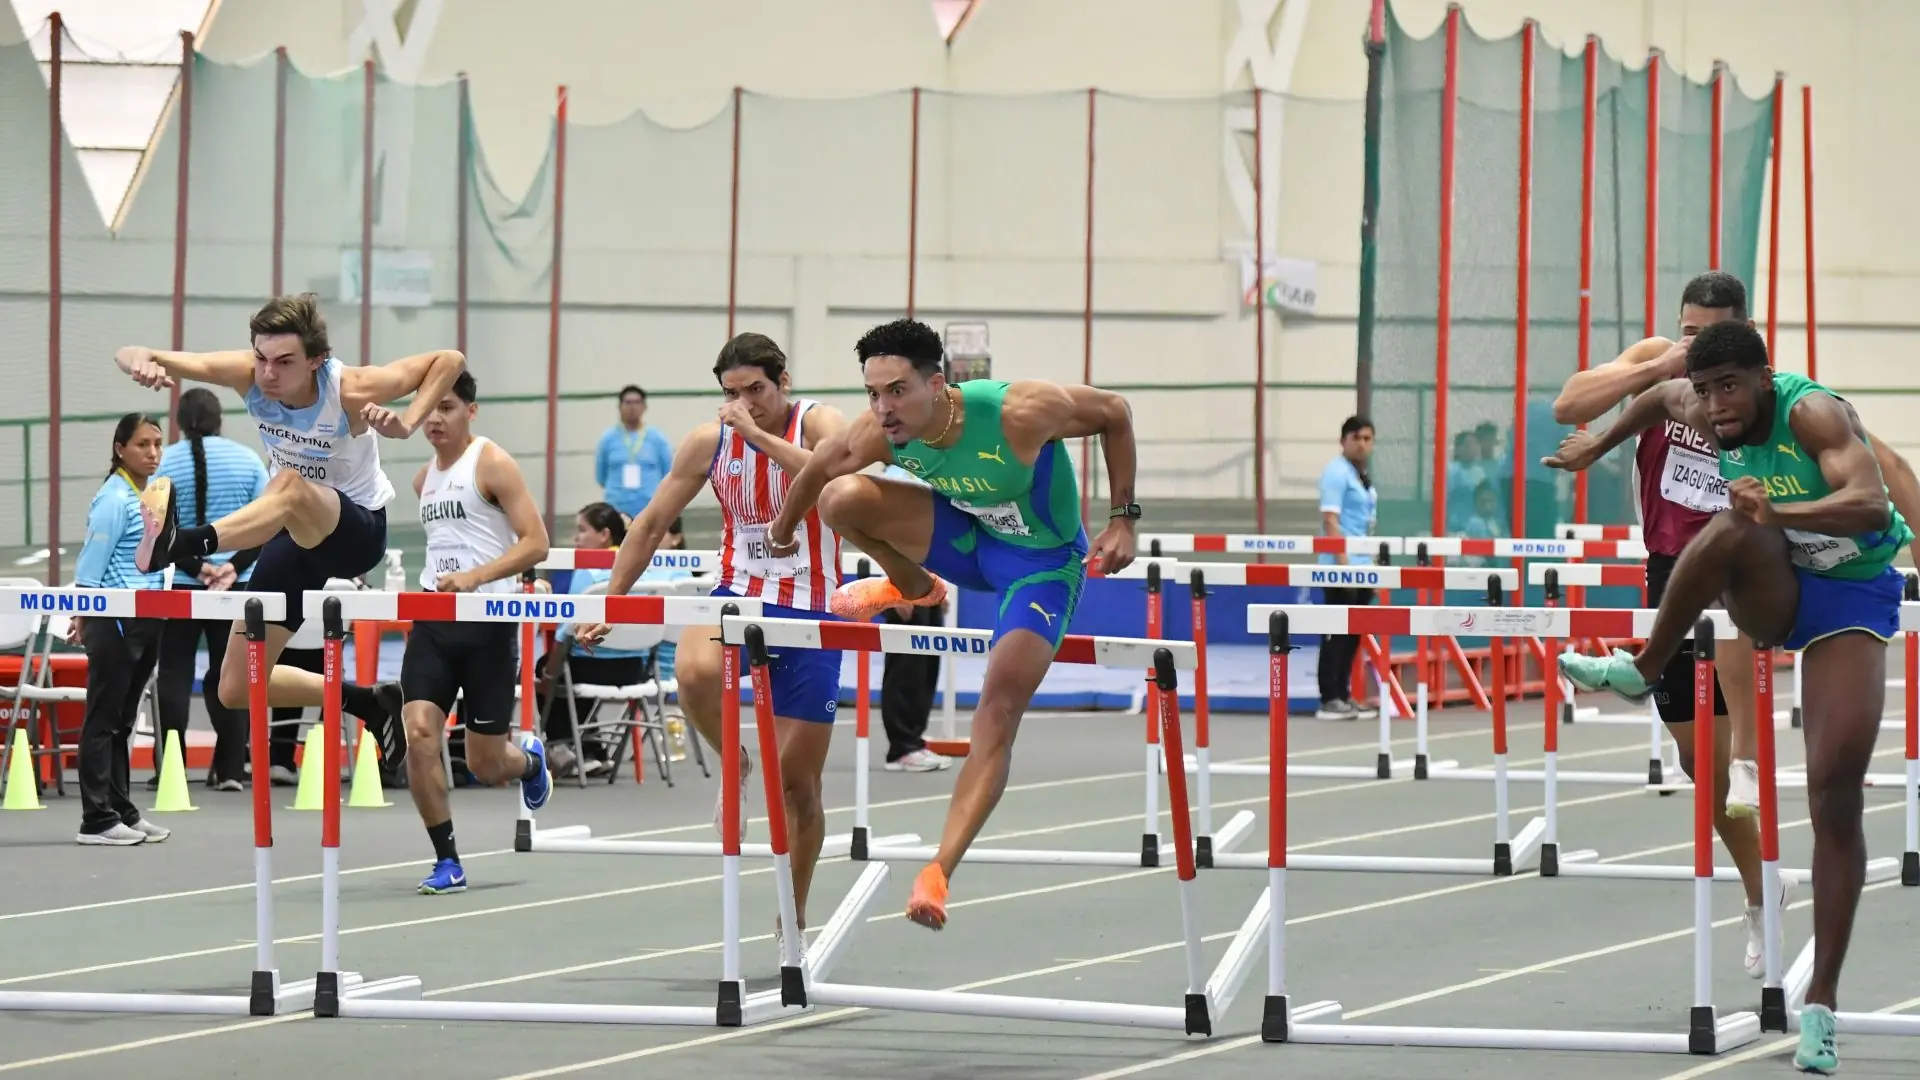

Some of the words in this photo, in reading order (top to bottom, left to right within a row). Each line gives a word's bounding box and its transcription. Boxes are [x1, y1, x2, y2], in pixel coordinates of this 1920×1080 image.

[258, 422, 331, 449] ARGENTINA
[1664, 419, 1718, 457] VENEZ
[1671, 463, 1730, 496] IZAGUIRRE
[1762, 474, 1809, 497] ASIL
[421, 500, 467, 524] BOLIVIA
[1243, 539, 1296, 550] MONDO
[1513, 543, 1566, 554] MONDO
[435, 557, 460, 574] LOAIZA
[652, 555, 701, 568] ONDO
[792, 567, 808, 577] 307
[1311, 571, 1379, 584] MONDO
[20, 593, 107, 612] MONDO
[485, 600, 575, 619] MONDO
